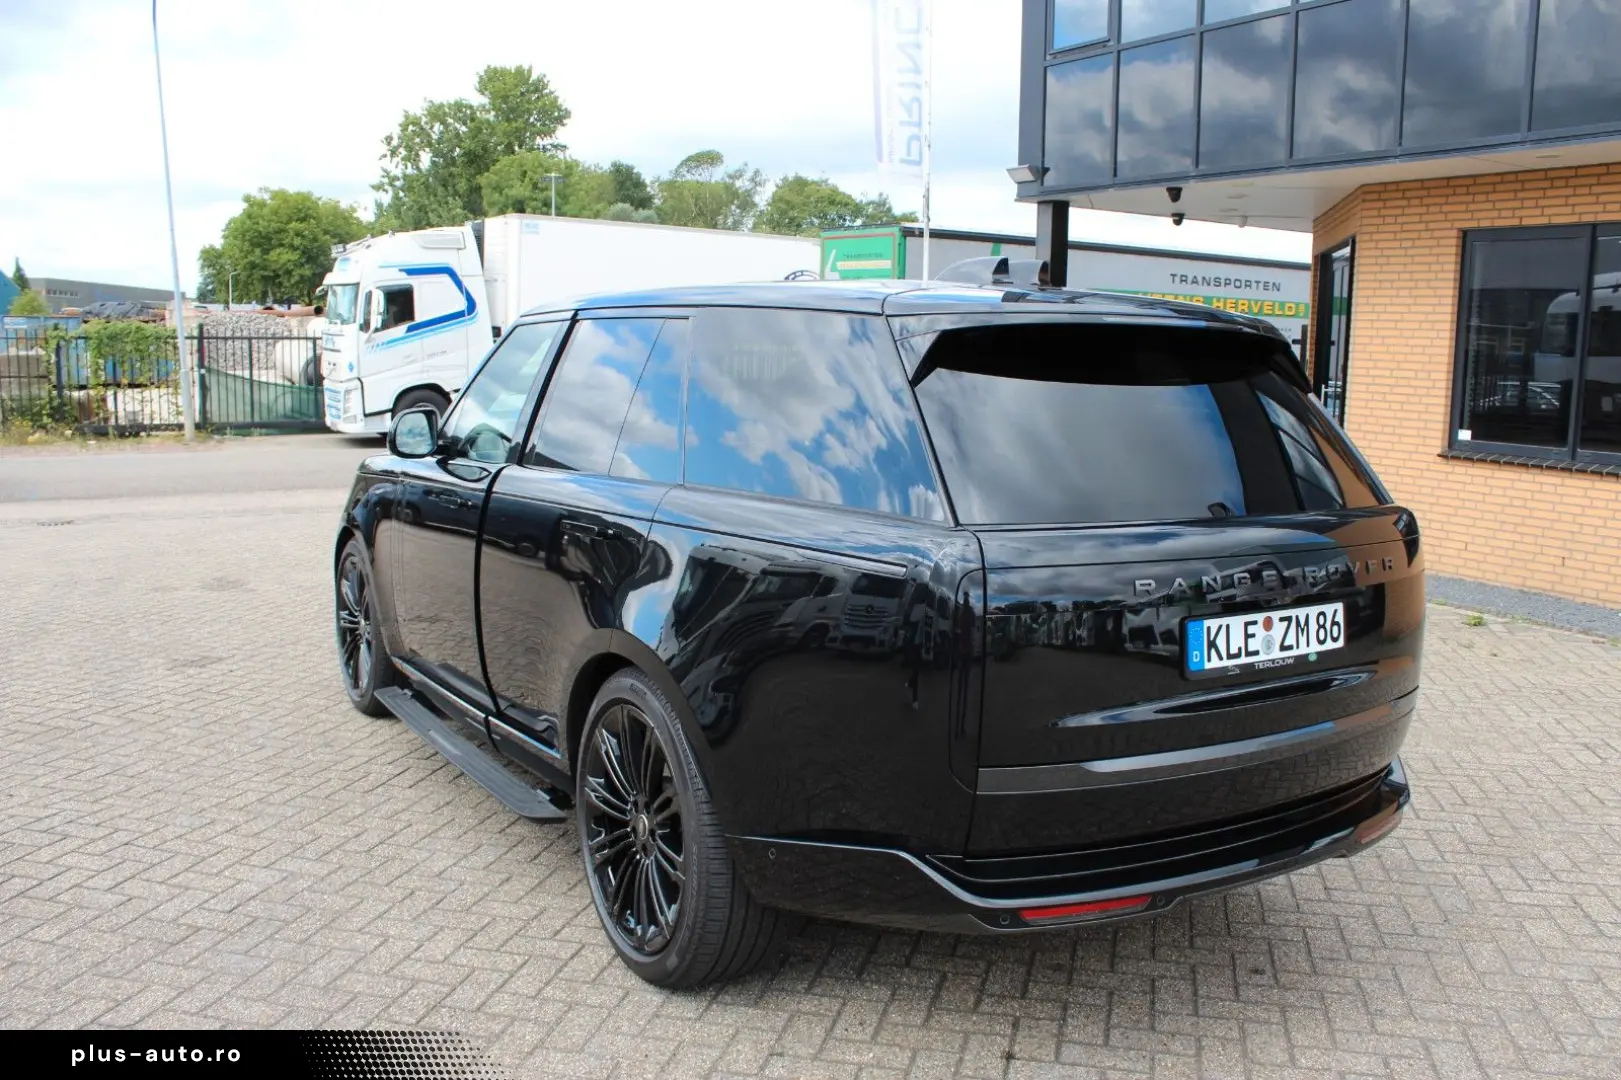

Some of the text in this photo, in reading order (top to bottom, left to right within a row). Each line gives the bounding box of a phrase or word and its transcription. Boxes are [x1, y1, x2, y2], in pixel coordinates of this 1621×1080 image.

[1169, 273, 1282, 292] TRANSPORTEN
[1133, 569, 1279, 597] RANGE
[1192, 607, 1342, 664] D KLE ZM 86
[1253, 657, 1295, 670] TERLOUW
